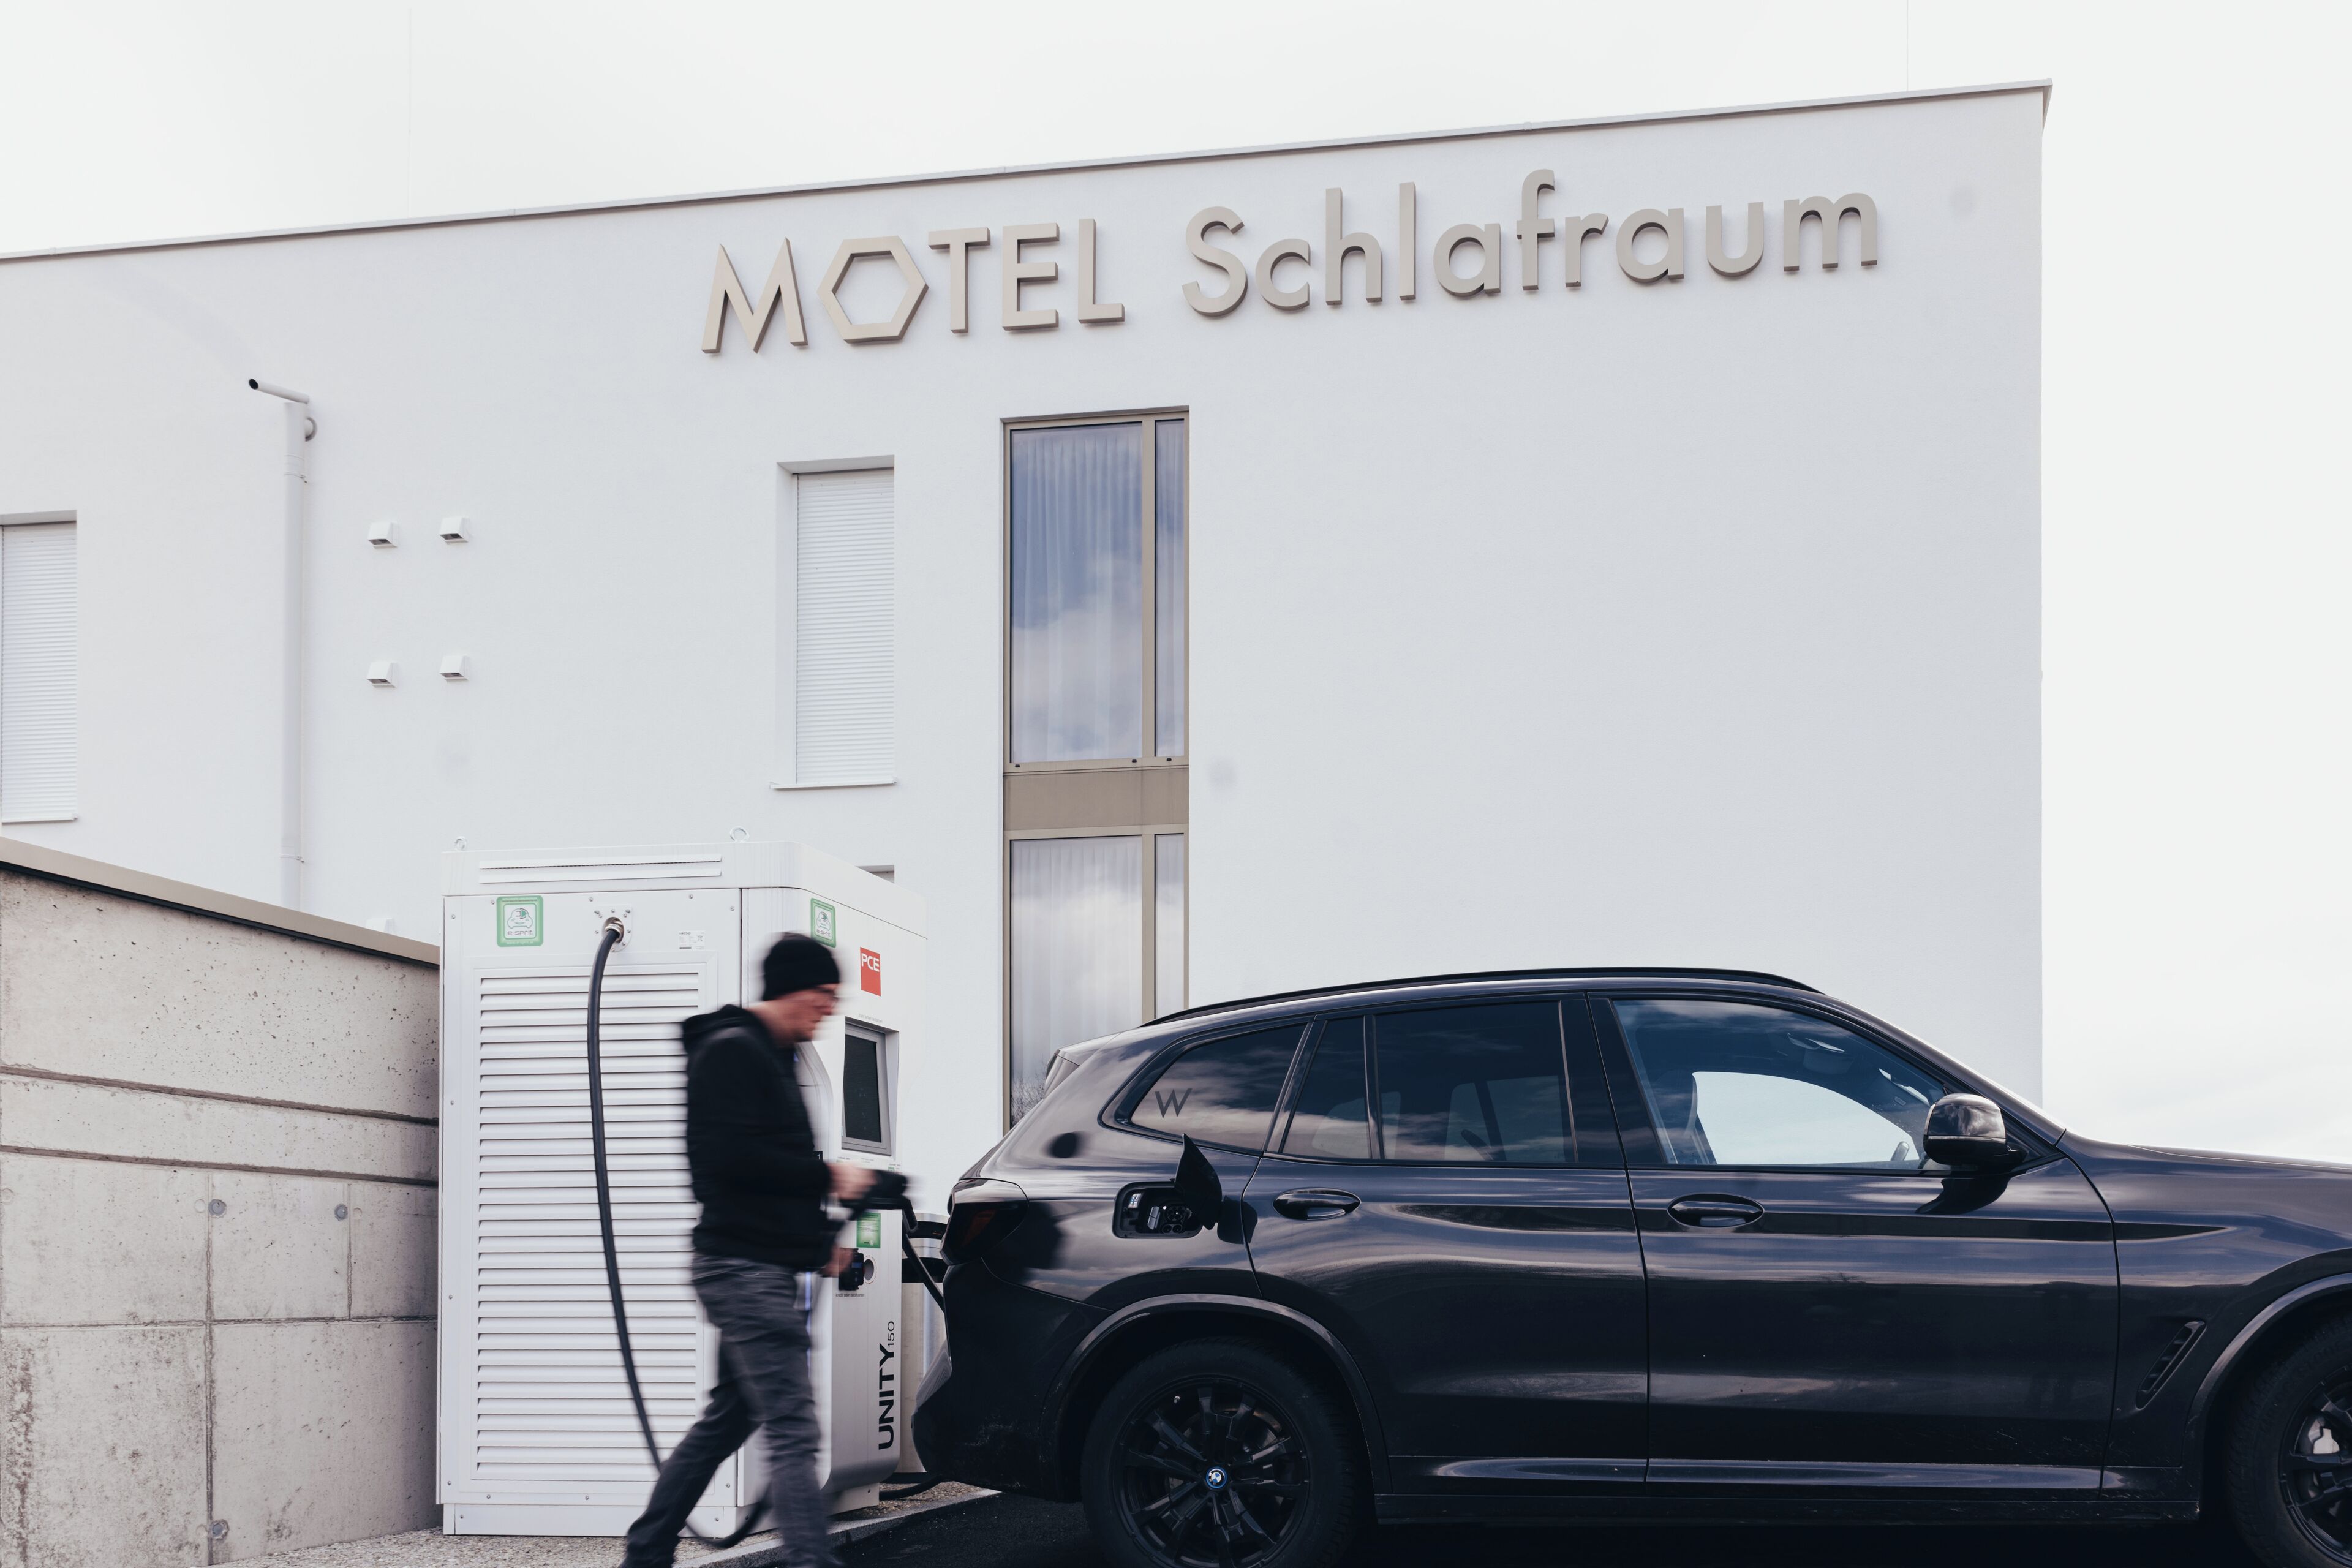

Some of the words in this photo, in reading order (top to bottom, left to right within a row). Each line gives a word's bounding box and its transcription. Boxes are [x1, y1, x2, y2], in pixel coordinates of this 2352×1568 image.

[701, 218, 1125, 353] MOTEL
[1182, 168, 1879, 318] Schlafraum
[861, 952, 880, 973] PCE
[1155, 1088, 1193, 1118] W
[878, 1343, 894, 1450] UNITY
